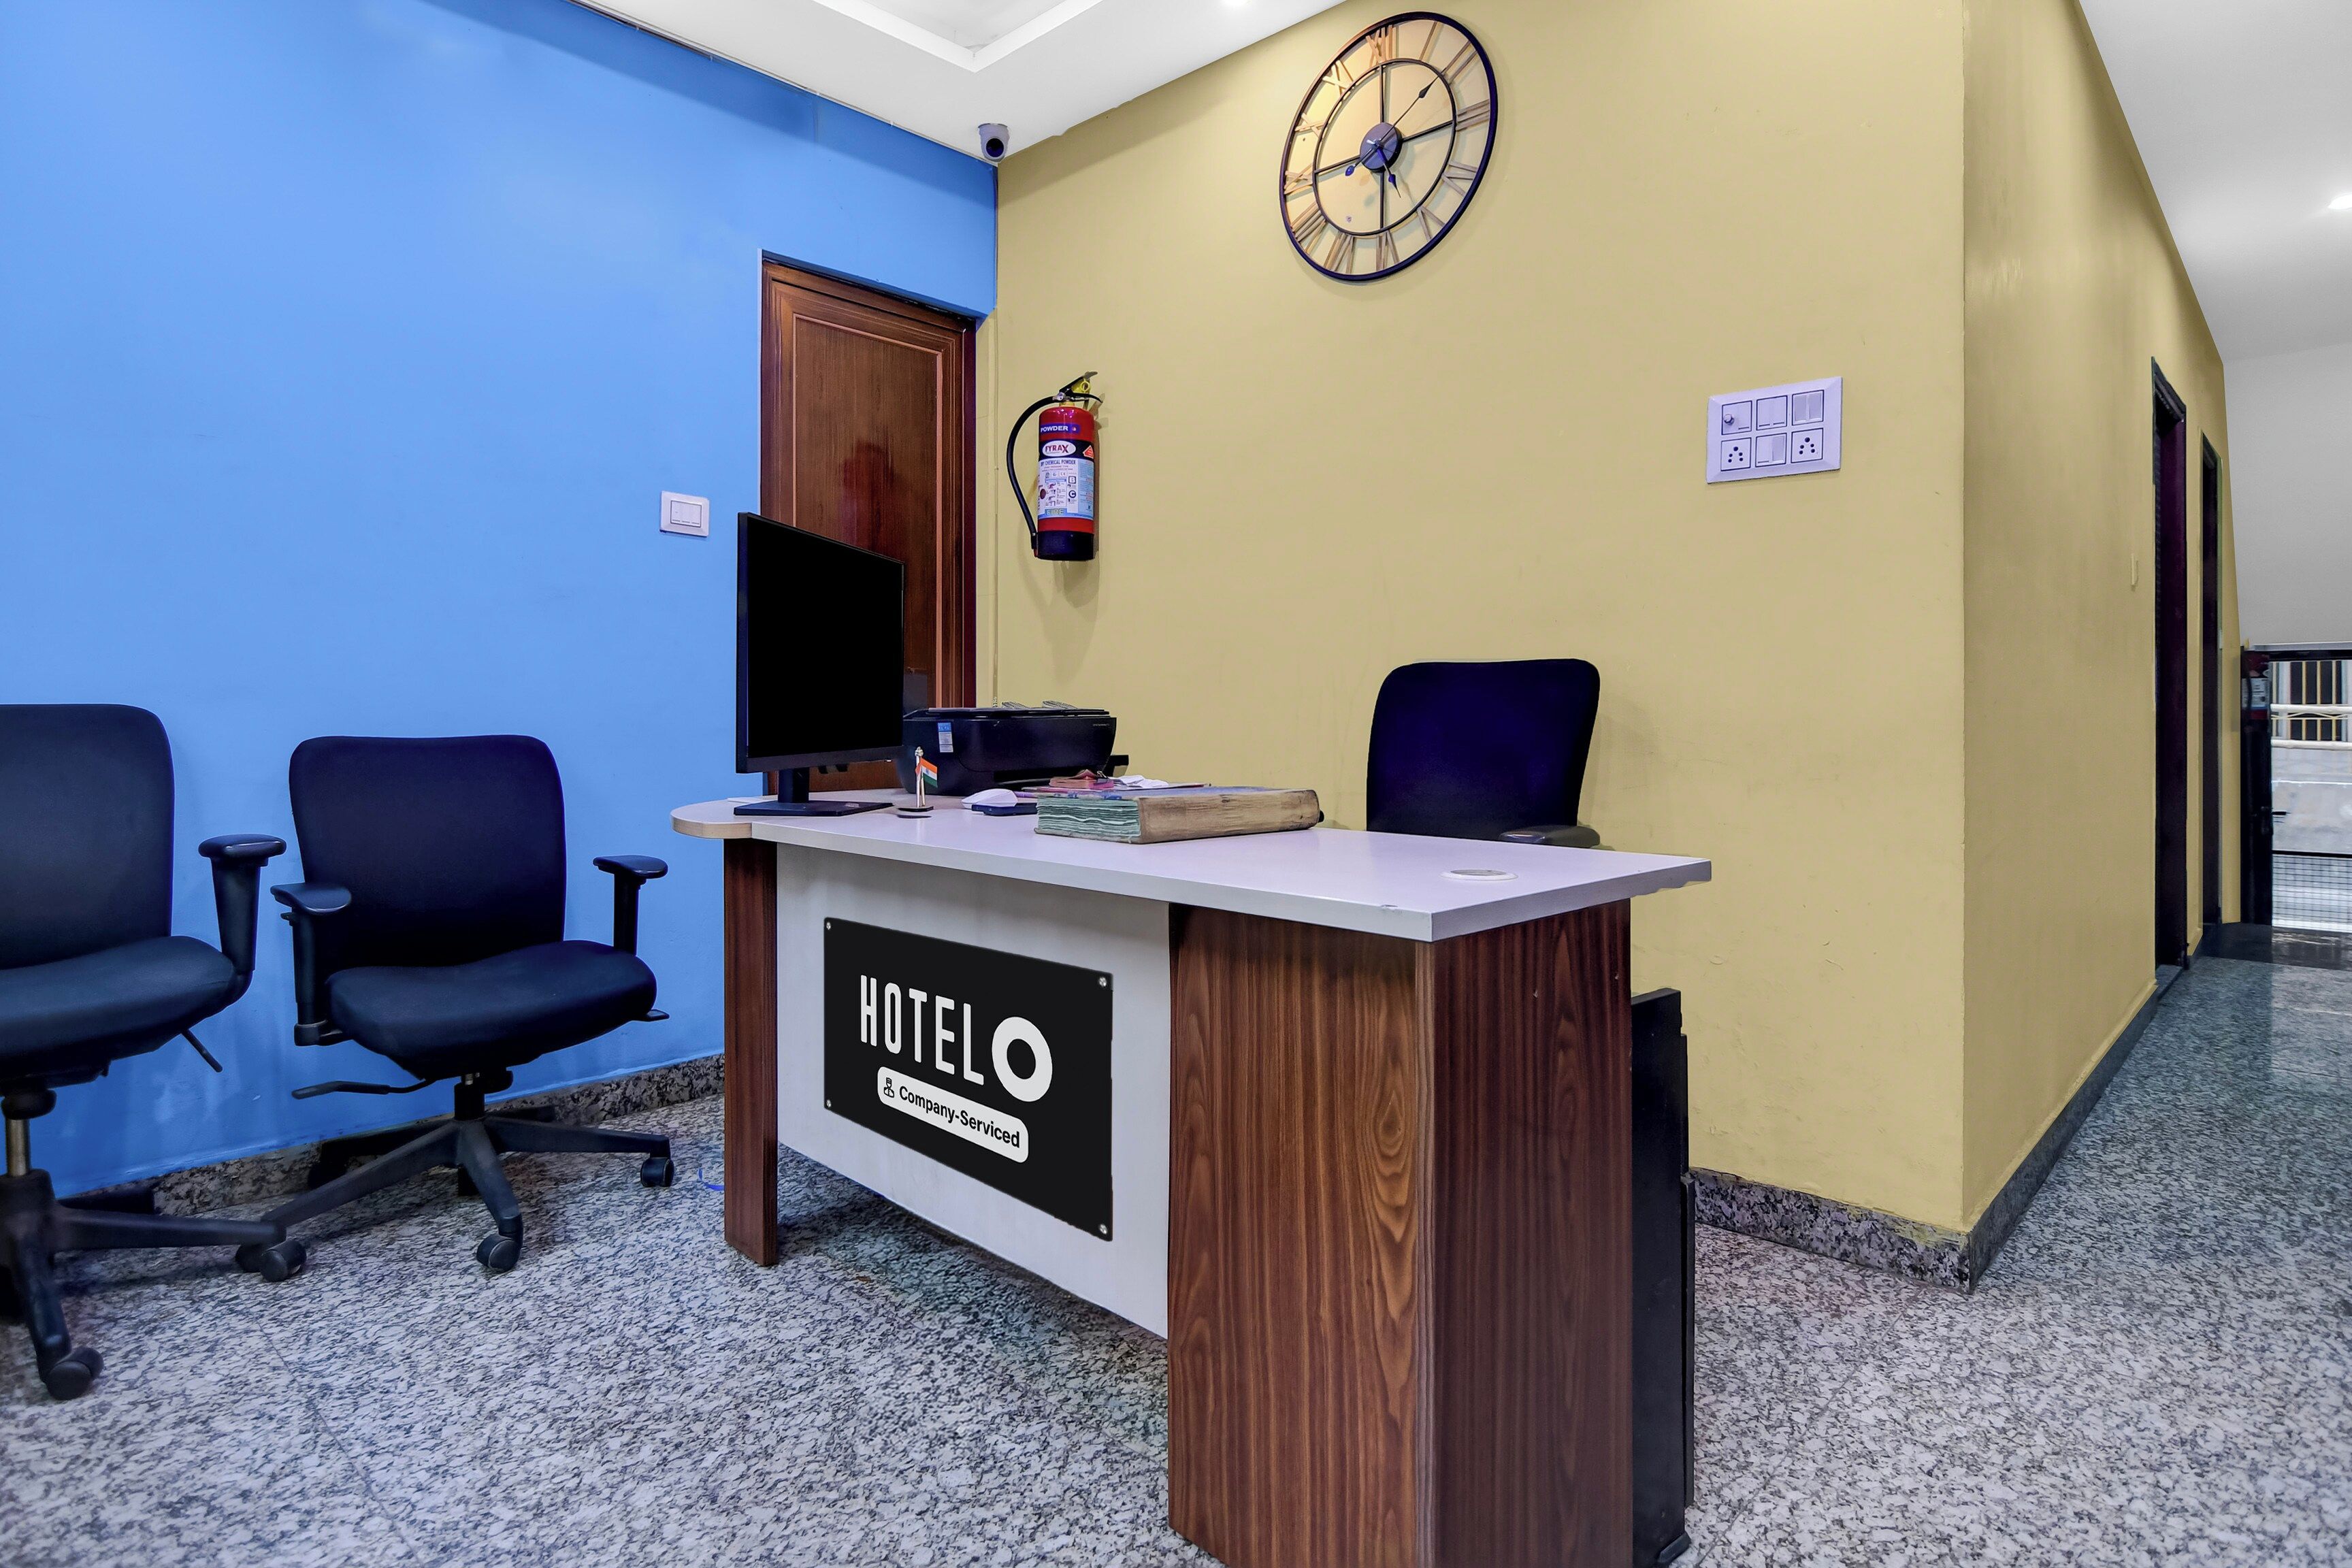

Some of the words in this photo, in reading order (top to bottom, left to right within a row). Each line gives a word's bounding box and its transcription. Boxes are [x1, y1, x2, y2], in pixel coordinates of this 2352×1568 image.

[1045, 444, 1068, 453] FYRAX
[860, 975, 984, 1085] HOTEL
[992, 1016, 1053, 1102] O
[899, 1085, 1020, 1149] Company-Serviced
